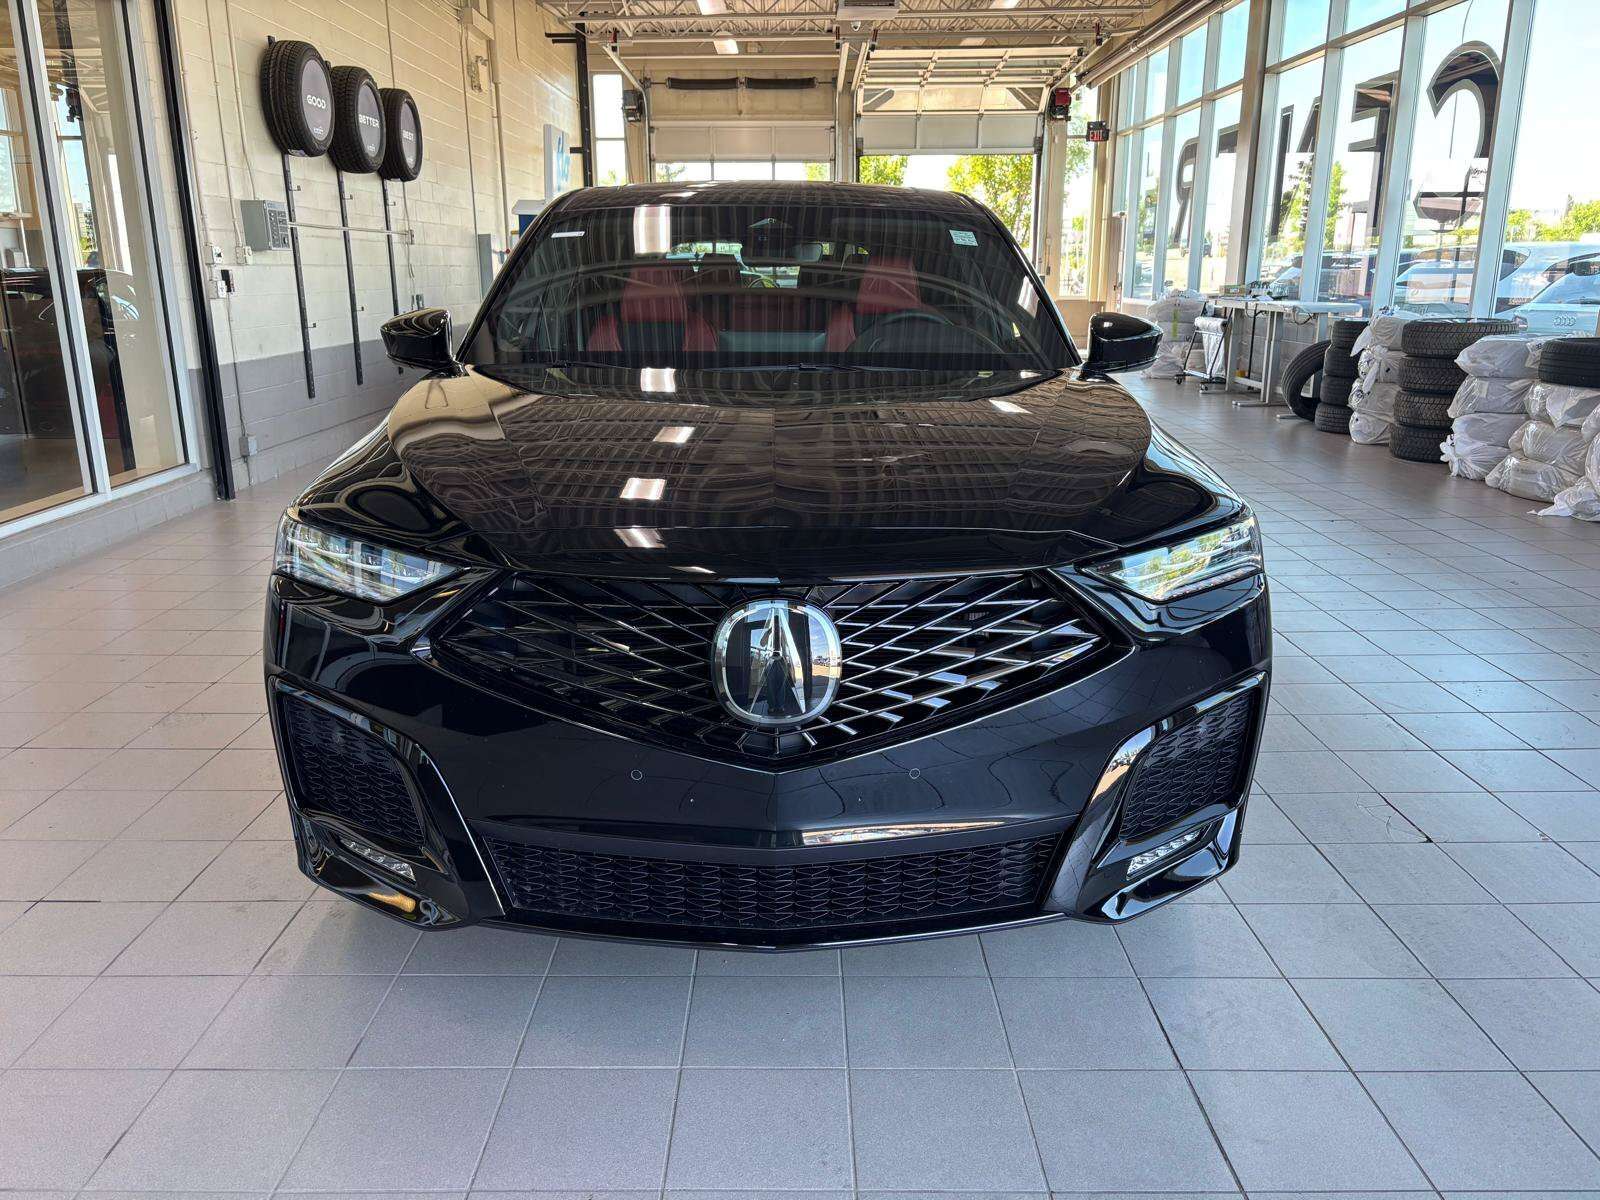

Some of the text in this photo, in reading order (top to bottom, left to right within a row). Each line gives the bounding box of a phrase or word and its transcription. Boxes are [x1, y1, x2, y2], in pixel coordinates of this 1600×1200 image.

[307, 95, 326, 109] GOOD
[358, 114, 380, 128] BETTER
[402, 130, 414, 141] BEST
